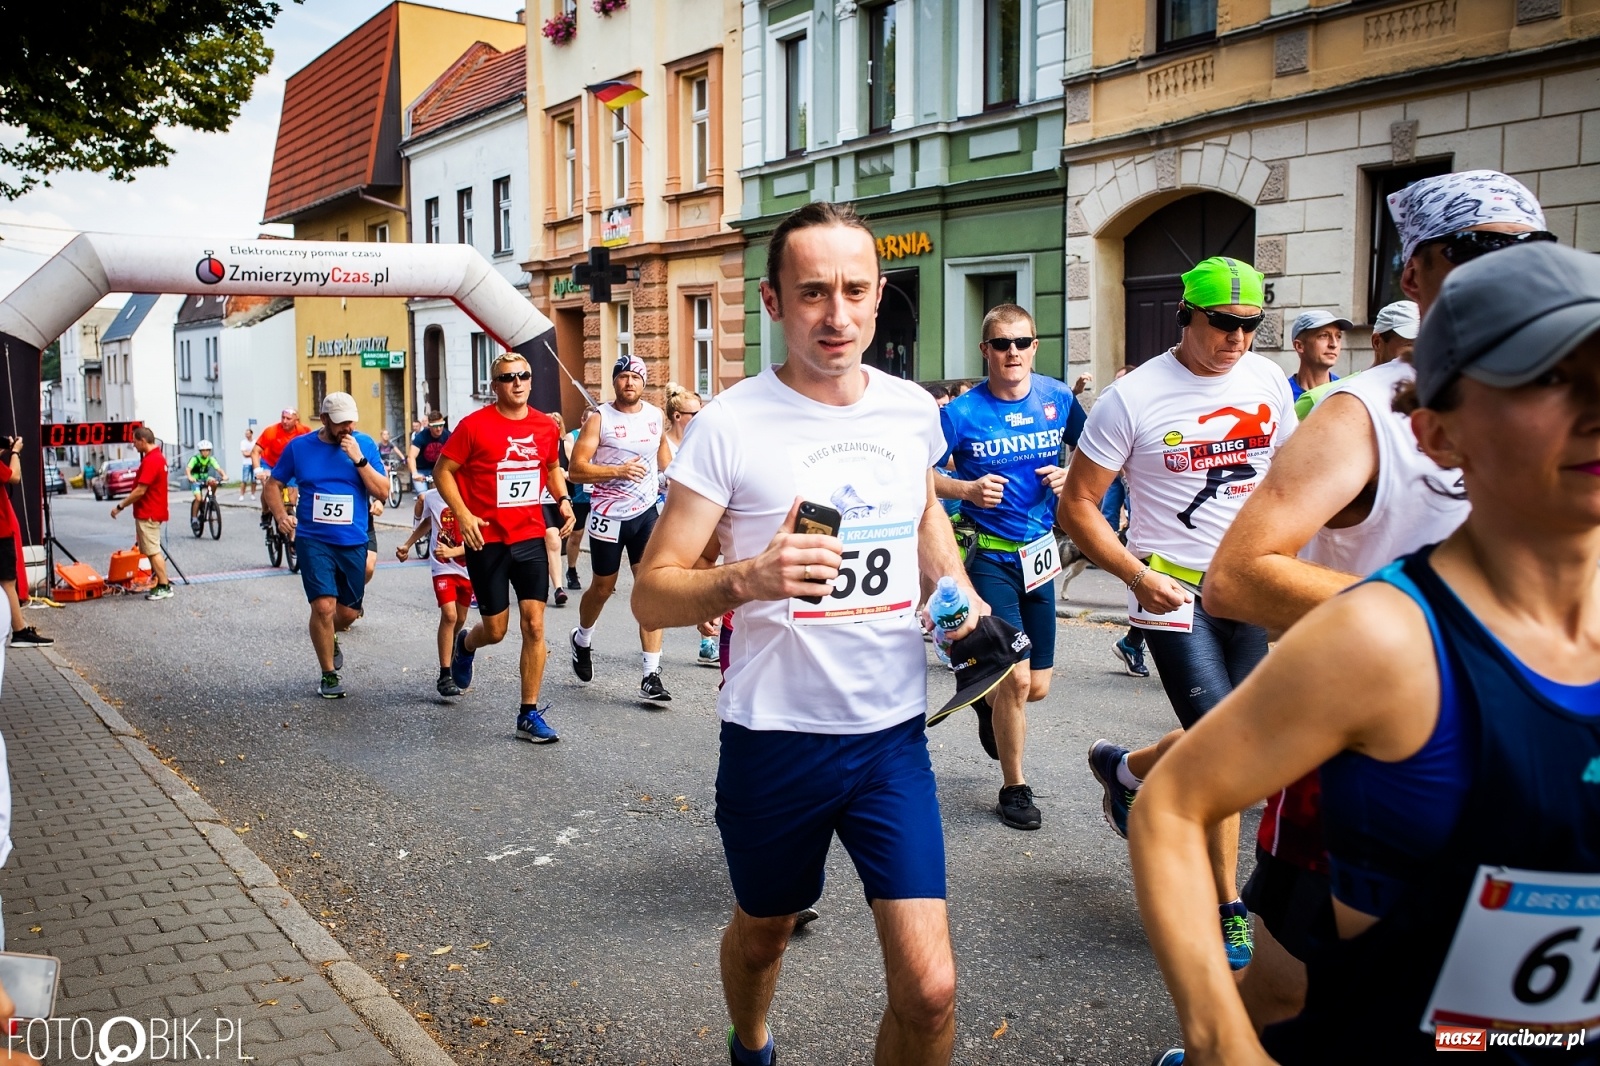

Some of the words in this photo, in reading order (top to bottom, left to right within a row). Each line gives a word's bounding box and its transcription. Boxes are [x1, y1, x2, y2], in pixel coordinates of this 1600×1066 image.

[229, 245, 308, 259] Elektroniczny
[311, 249, 348, 259] pomiar
[352, 250, 381, 258] czasu
[229, 264, 389, 287] ZmierzymyCzas.pl
[1263, 282, 1275, 304] 5
[808, 447, 830, 464] BIEG
[830, 442, 896, 462] KRZANOWICKI
[1037, 450, 1058, 459] TEAM
[1193, 445, 1208, 457] XI
[1212, 440, 1245, 454] BIEG
[1248, 435, 1270, 448] BEZ
[1194, 452, 1247, 470] GRANIC
[508, 481, 531, 498] 57
[322, 502, 344, 517] 55
[590, 516, 610, 533] 35
[846, 524, 912, 541] KRZANOWICKI
[1034, 548, 1052, 576] 60
[831, 548, 891, 600] 58
